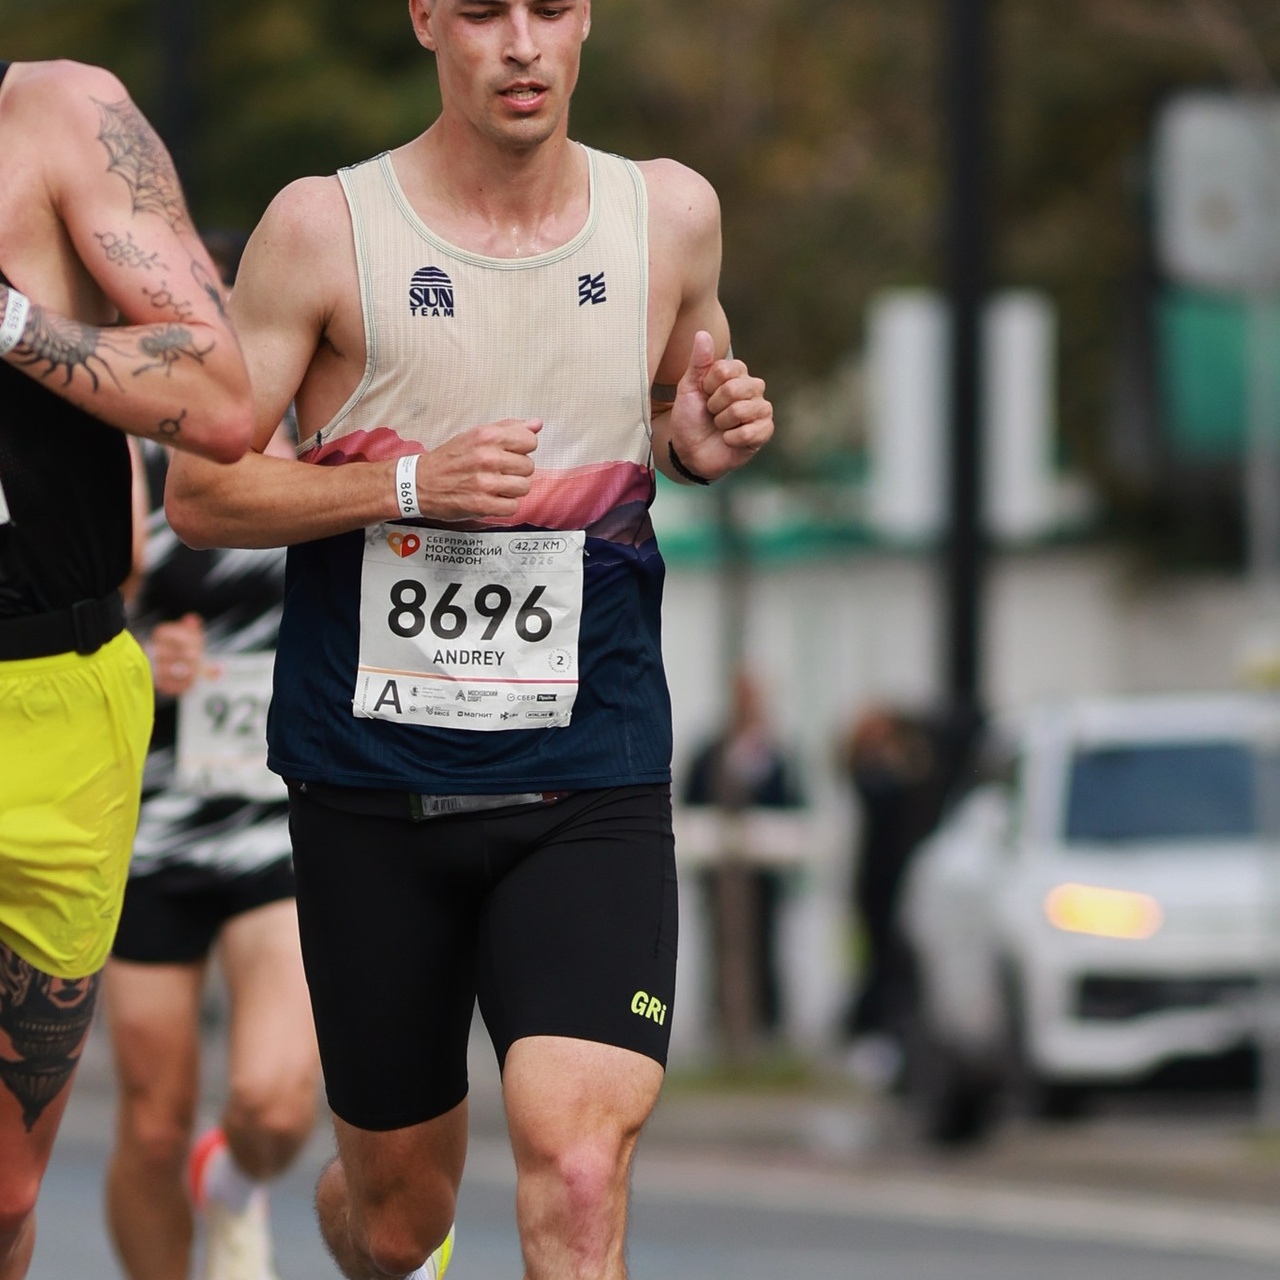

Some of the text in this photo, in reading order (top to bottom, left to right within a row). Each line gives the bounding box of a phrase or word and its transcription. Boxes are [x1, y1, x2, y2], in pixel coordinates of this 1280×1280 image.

[409, 287, 454, 307] SUN
[410, 307, 454, 317] TEAM
[401, 481, 415, 513] 8696
[427, 535, 483, 547] СБЕРПРАЙМ
[515, 541, 539, 552] 42,2
[426, 544, 502, 556] МОСКОВСКИЙ
[425, 553, 482, 565] МАРАФОН
[388, 579, 553, 643] 8696
[433, 650, 506, 666] ANDREY
[556, 655, 564, 666] 2
[631, 990, 667, 1026] GRi
